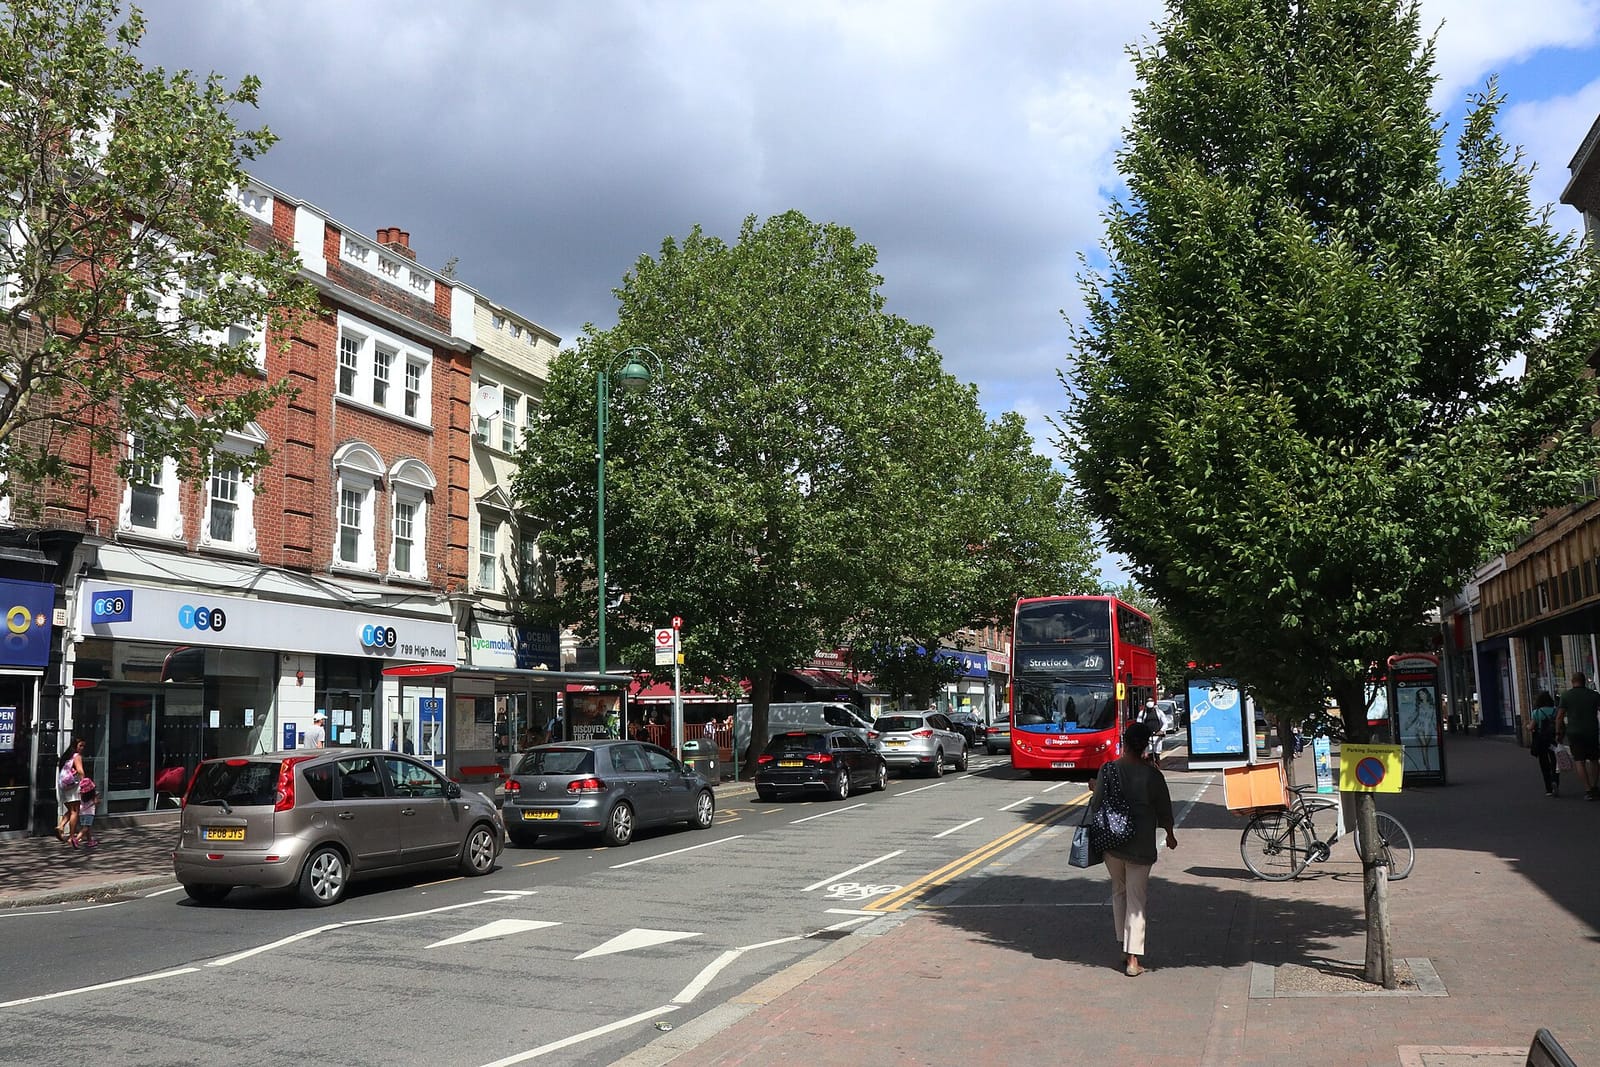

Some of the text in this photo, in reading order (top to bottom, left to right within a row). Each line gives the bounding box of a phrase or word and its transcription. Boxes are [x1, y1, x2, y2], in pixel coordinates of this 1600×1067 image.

[96, 601, 123, 614] TSB
[182, 608, 225, 629] TSB
[364, 627, 396, 645] TSB
[401, 644, 446, 657] 799 High Road
[1030, 656, 1099, 668] Stratford 257
